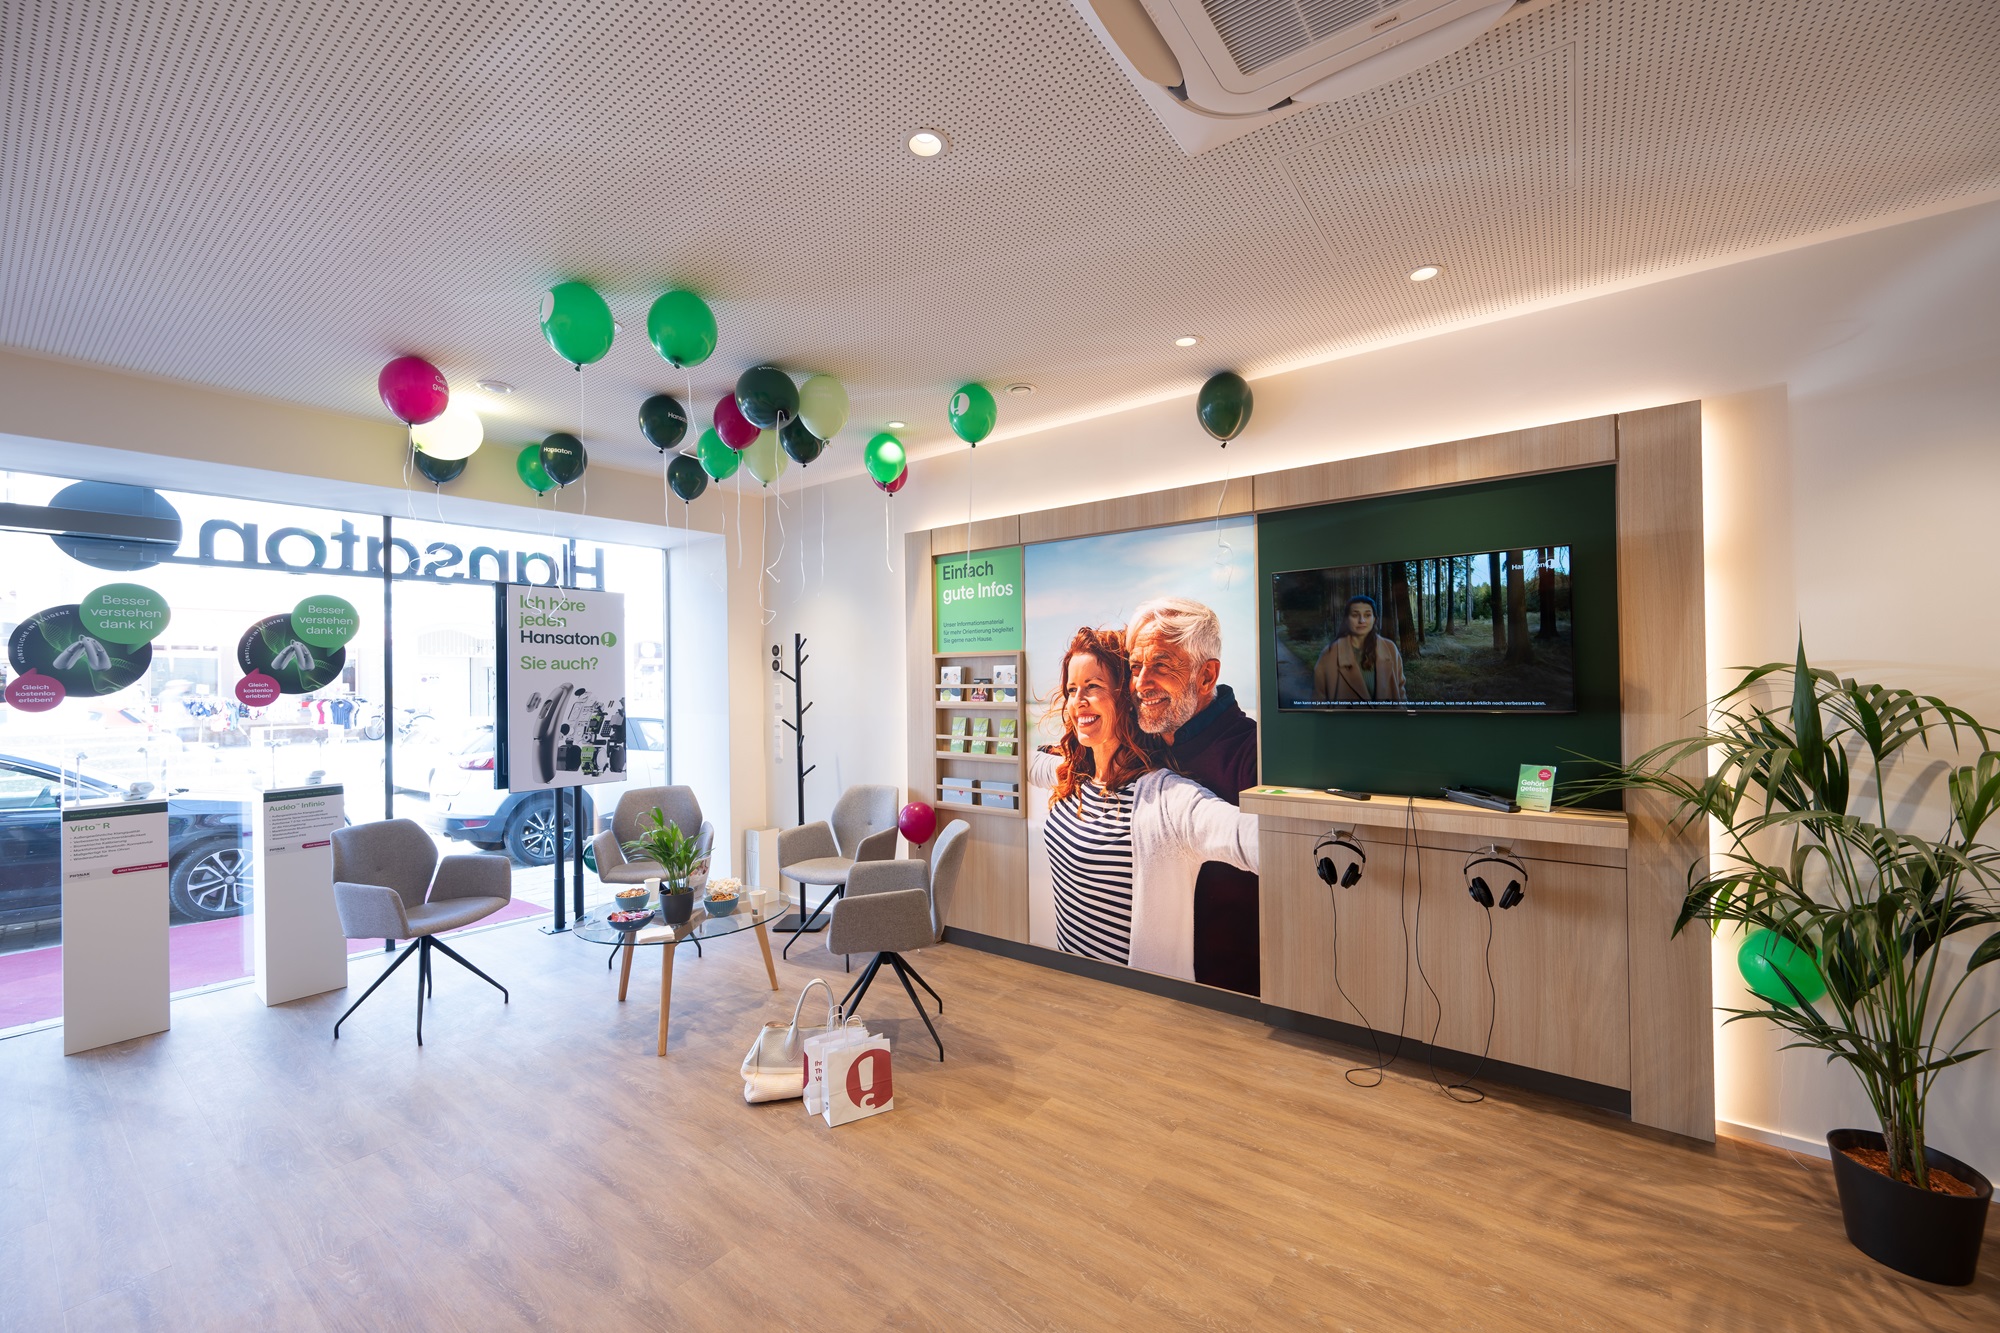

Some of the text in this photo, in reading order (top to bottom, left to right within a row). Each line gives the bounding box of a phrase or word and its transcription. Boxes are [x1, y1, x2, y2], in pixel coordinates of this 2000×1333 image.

[543, 446, 573, 456] Hansaton
[943, 560, 994, 580] Einfach
[943, 581, 1013, 605] gute Infos
[102, 595, 151, 605] Besser
[520, 595, 586, 612] Ich höre
[90, 608, 162, 618] verstehen
[308, 605, 345, 614] Besser
[100, 619, 153, 630] dank KI
[299, 617, 353, 625] verstehen
[519, 612, 566, 629] jeden
[306, 626, 347, 635] dank KI
[520, 630, 600, 645] Hansaton
[520, 655, 599, 670] Sie auch?
[1521, 779, 1545, 787] Gehört
